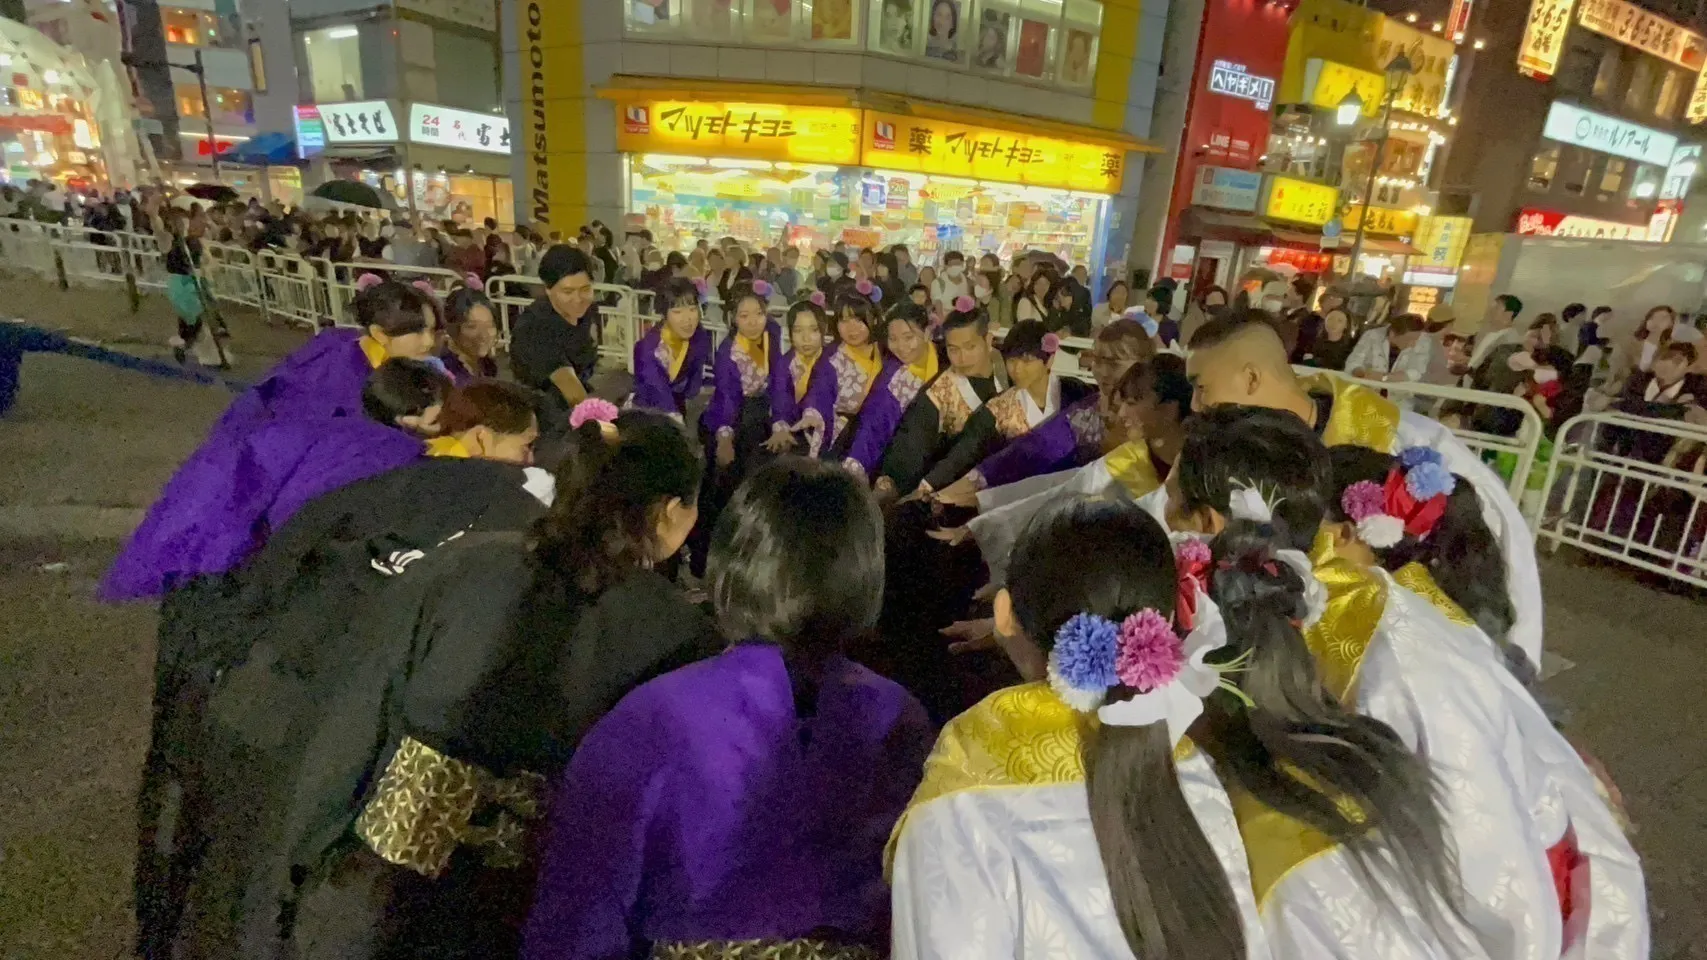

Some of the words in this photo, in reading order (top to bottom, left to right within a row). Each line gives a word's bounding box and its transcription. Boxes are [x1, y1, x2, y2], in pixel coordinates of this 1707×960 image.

[421, 114, 441, 126] 24
[527, 2, 550, 224] Matsumoto
[660, 106, 797, 143] マツモトキヨシ
[421, 126, 440, 138] 時間
[908, 126, 933, 155] 薬
[944, 131, 1045, 168] マツモトキヨシ
[1099, 152, 1121, 178] 薬
